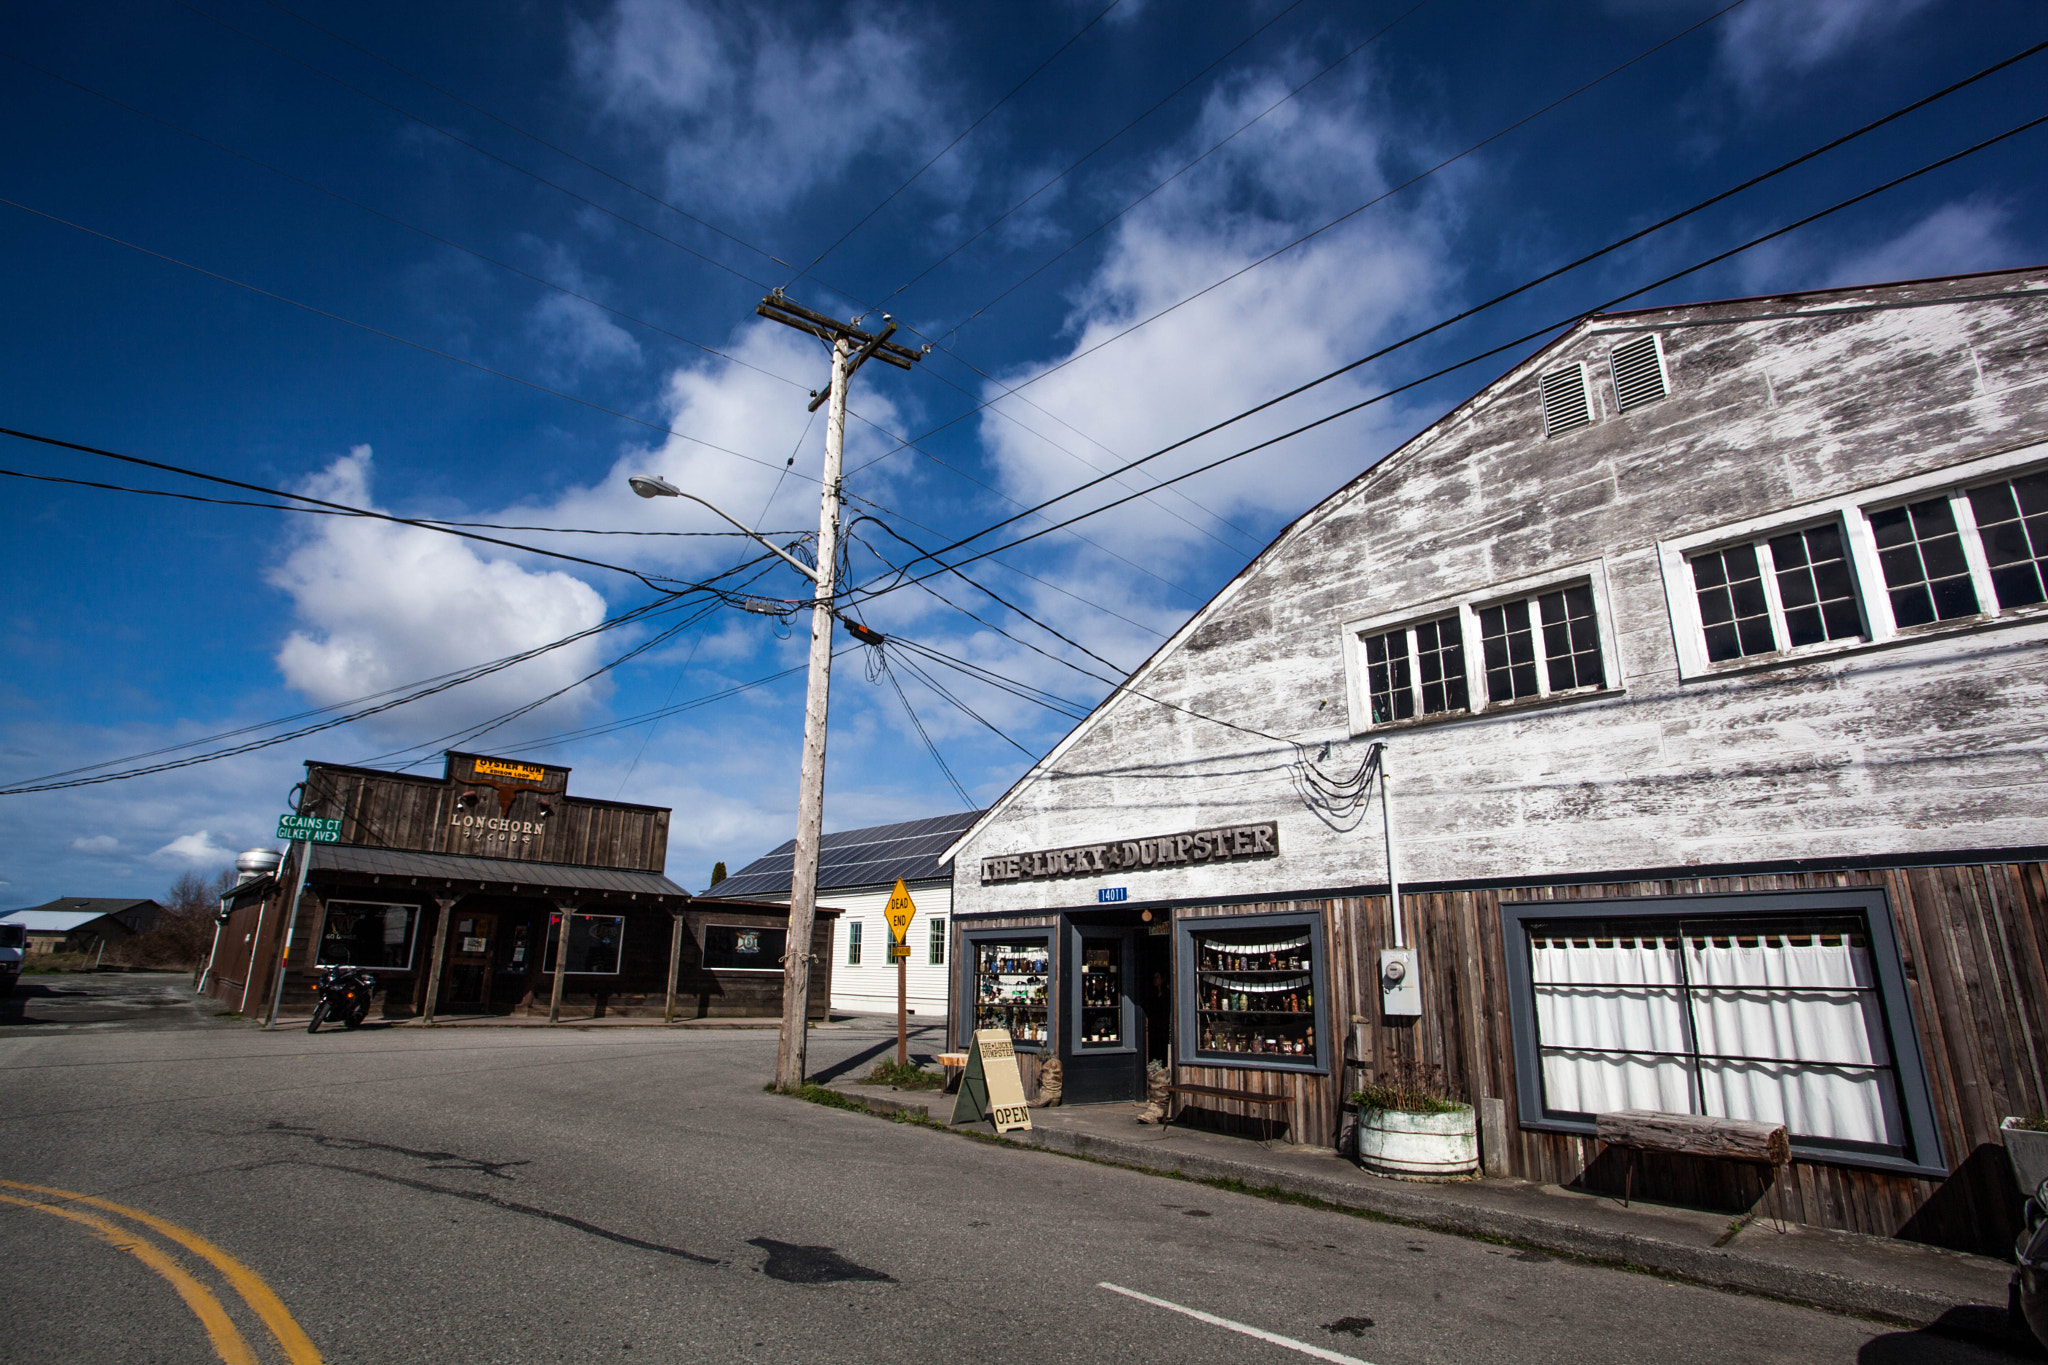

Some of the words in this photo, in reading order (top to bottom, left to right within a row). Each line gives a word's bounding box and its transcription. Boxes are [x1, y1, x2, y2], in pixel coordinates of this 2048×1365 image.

[479, 758, 519, 771] OYSTER
[522, 764, 543, 774] RUN
[490, 769, 512, 777] EDISON
[289, 816, 323, 829] CAINS
[326, 820, 341, 831] CT
[451, 814, 544, 835] LONGHORN
[278, 827, 312, 840] GILKEY
[313, 830, 332, 842] AVE
[981, 856, 1020, 881] THE
[1033, 845, 1106, 876] LUCKY
[1122, 824, 1275, 867] DUMPSTER
[1101, 888, 1124, 902] 14011
[891, 897, 909, 910] DEAD
[893, 915, 907, 927] END
[980, 1042, 992, 1050] THE
[994, 1041, 1013, 1050] LUCKY
[982, 1048, 1015, 1059] DUMPSTER
[995, 1106, 1029, 1125] OPEN
